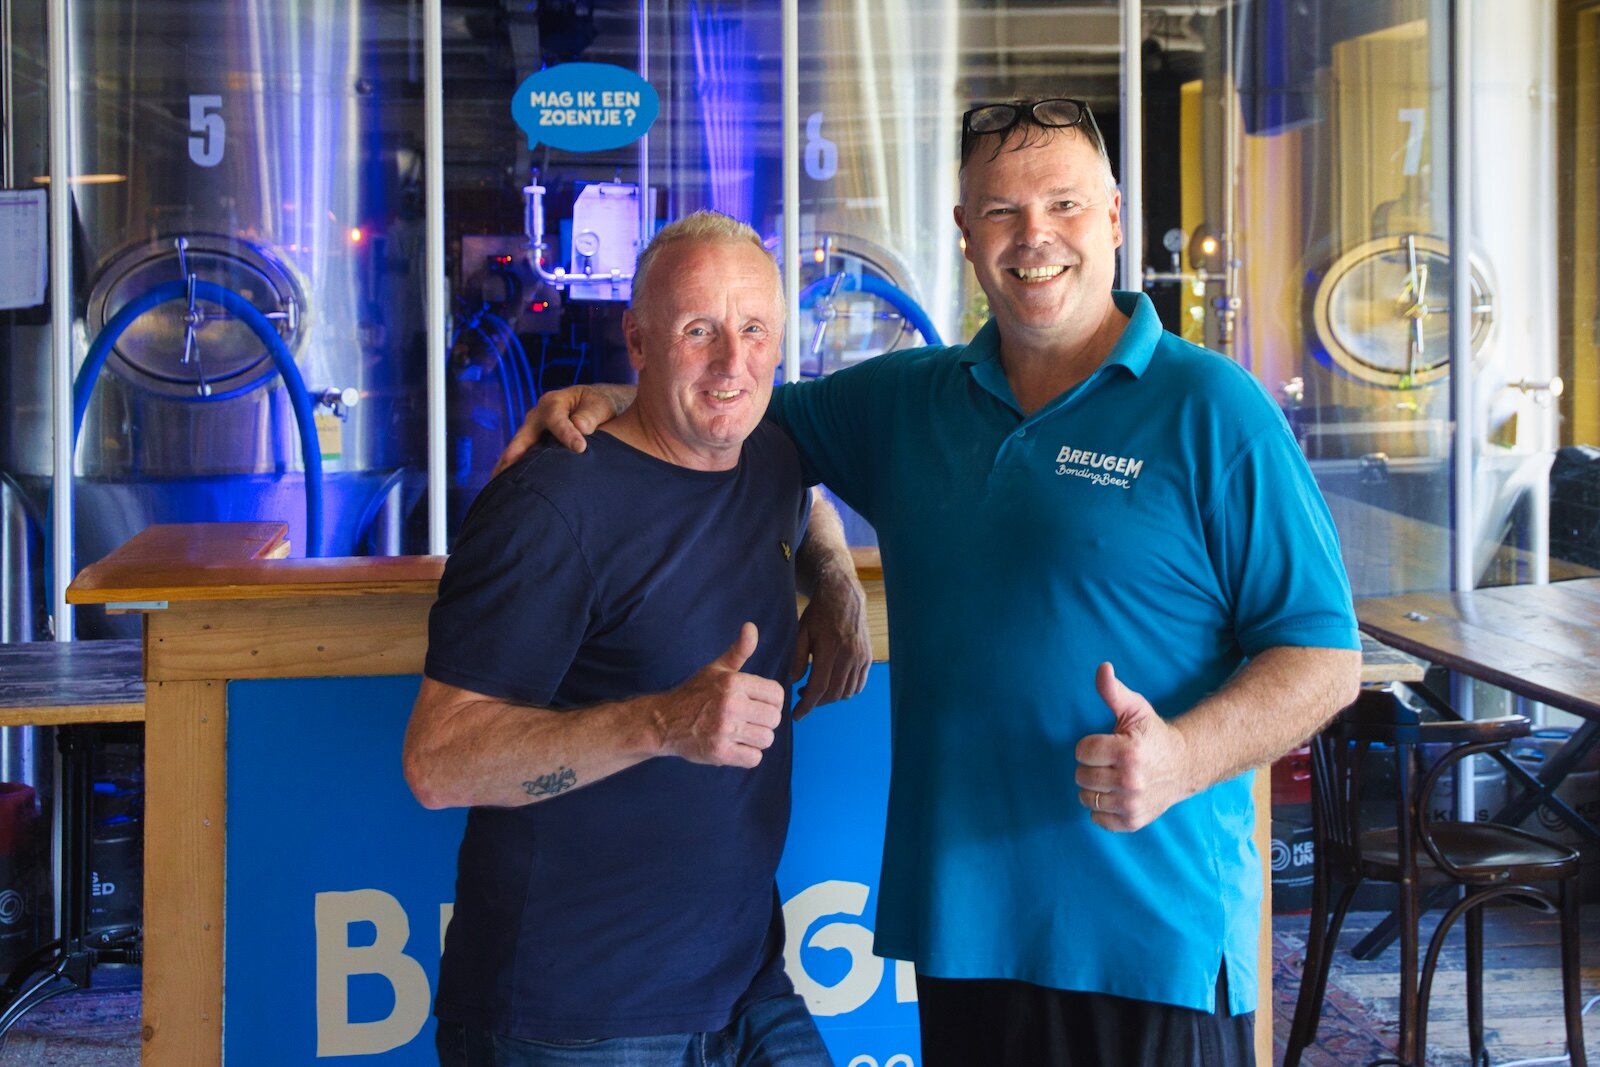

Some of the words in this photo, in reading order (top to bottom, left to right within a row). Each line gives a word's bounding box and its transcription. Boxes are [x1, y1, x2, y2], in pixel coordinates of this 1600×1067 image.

[530, 91, 574, 107] MAG
[577, 91, 597, 107] IK
[602, 91, 640, 107] EEN
[539, 109, 621, 126] ZOENTJE
[188, 94, 226, 167] 5
[804, 111, 838, 181] 6
[1397, 108, 1425, 176] 7
[1055, 445, 1144, 479] BREUGEM
